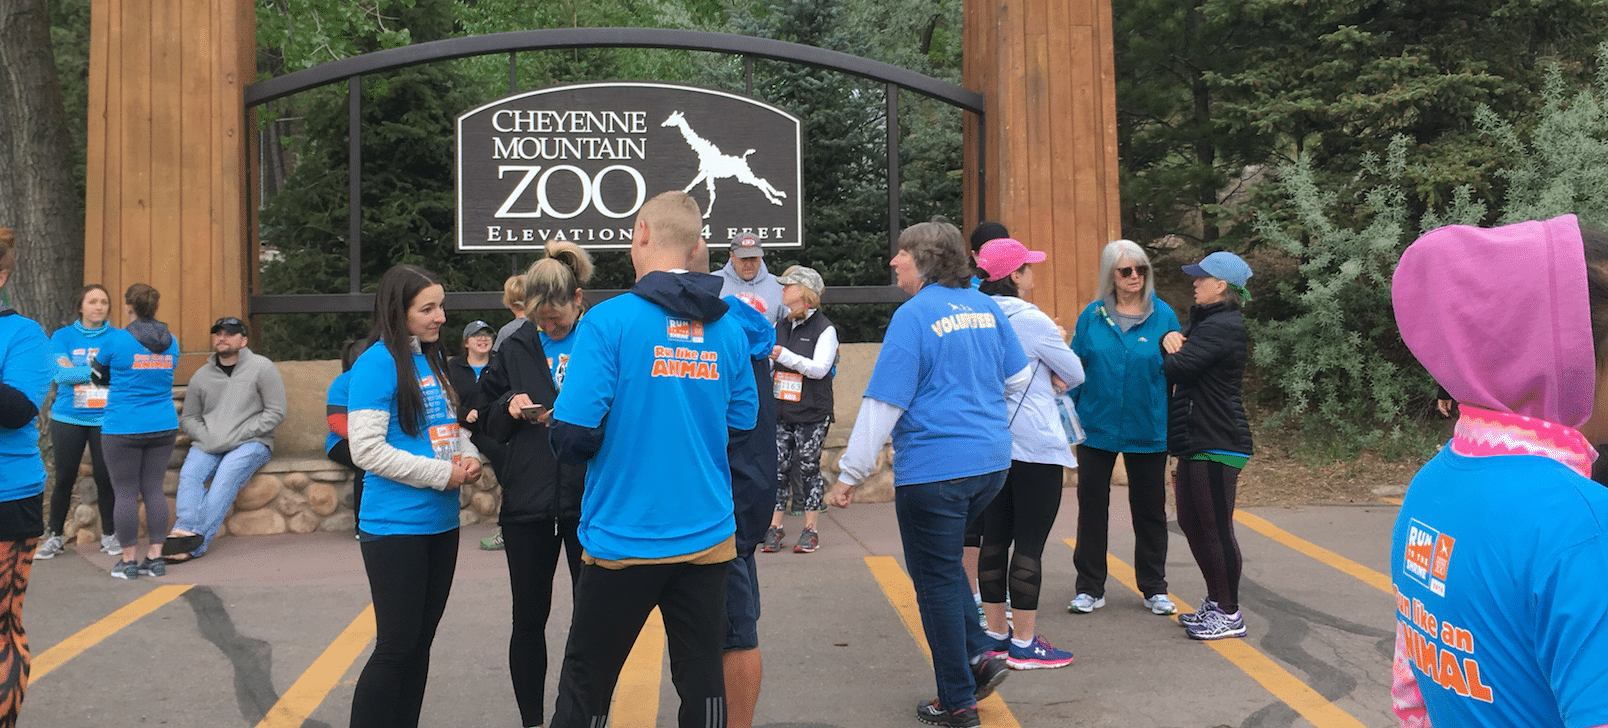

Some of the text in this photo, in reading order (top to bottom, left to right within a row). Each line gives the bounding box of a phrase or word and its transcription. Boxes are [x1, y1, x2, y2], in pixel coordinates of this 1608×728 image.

[492, 109, 647, 133] CHEYENNE
[492, 137, 647, 160] MOUNTAIN
[494, 164, 647, 219] ZOO
[487, 226, 633, 242] ELEVATION
[931, 312, 996, 337] VOLUNTEER
[675, 347, 699, 360] like
[700, 351, 717, 362] an
[651, 359, 720, 380] ANIMAL
[1408, 526, 1432, 546] RUN
[1393, 583, 1474, 654] un like an
[1402, 620, 1493, 703] NIMAL
